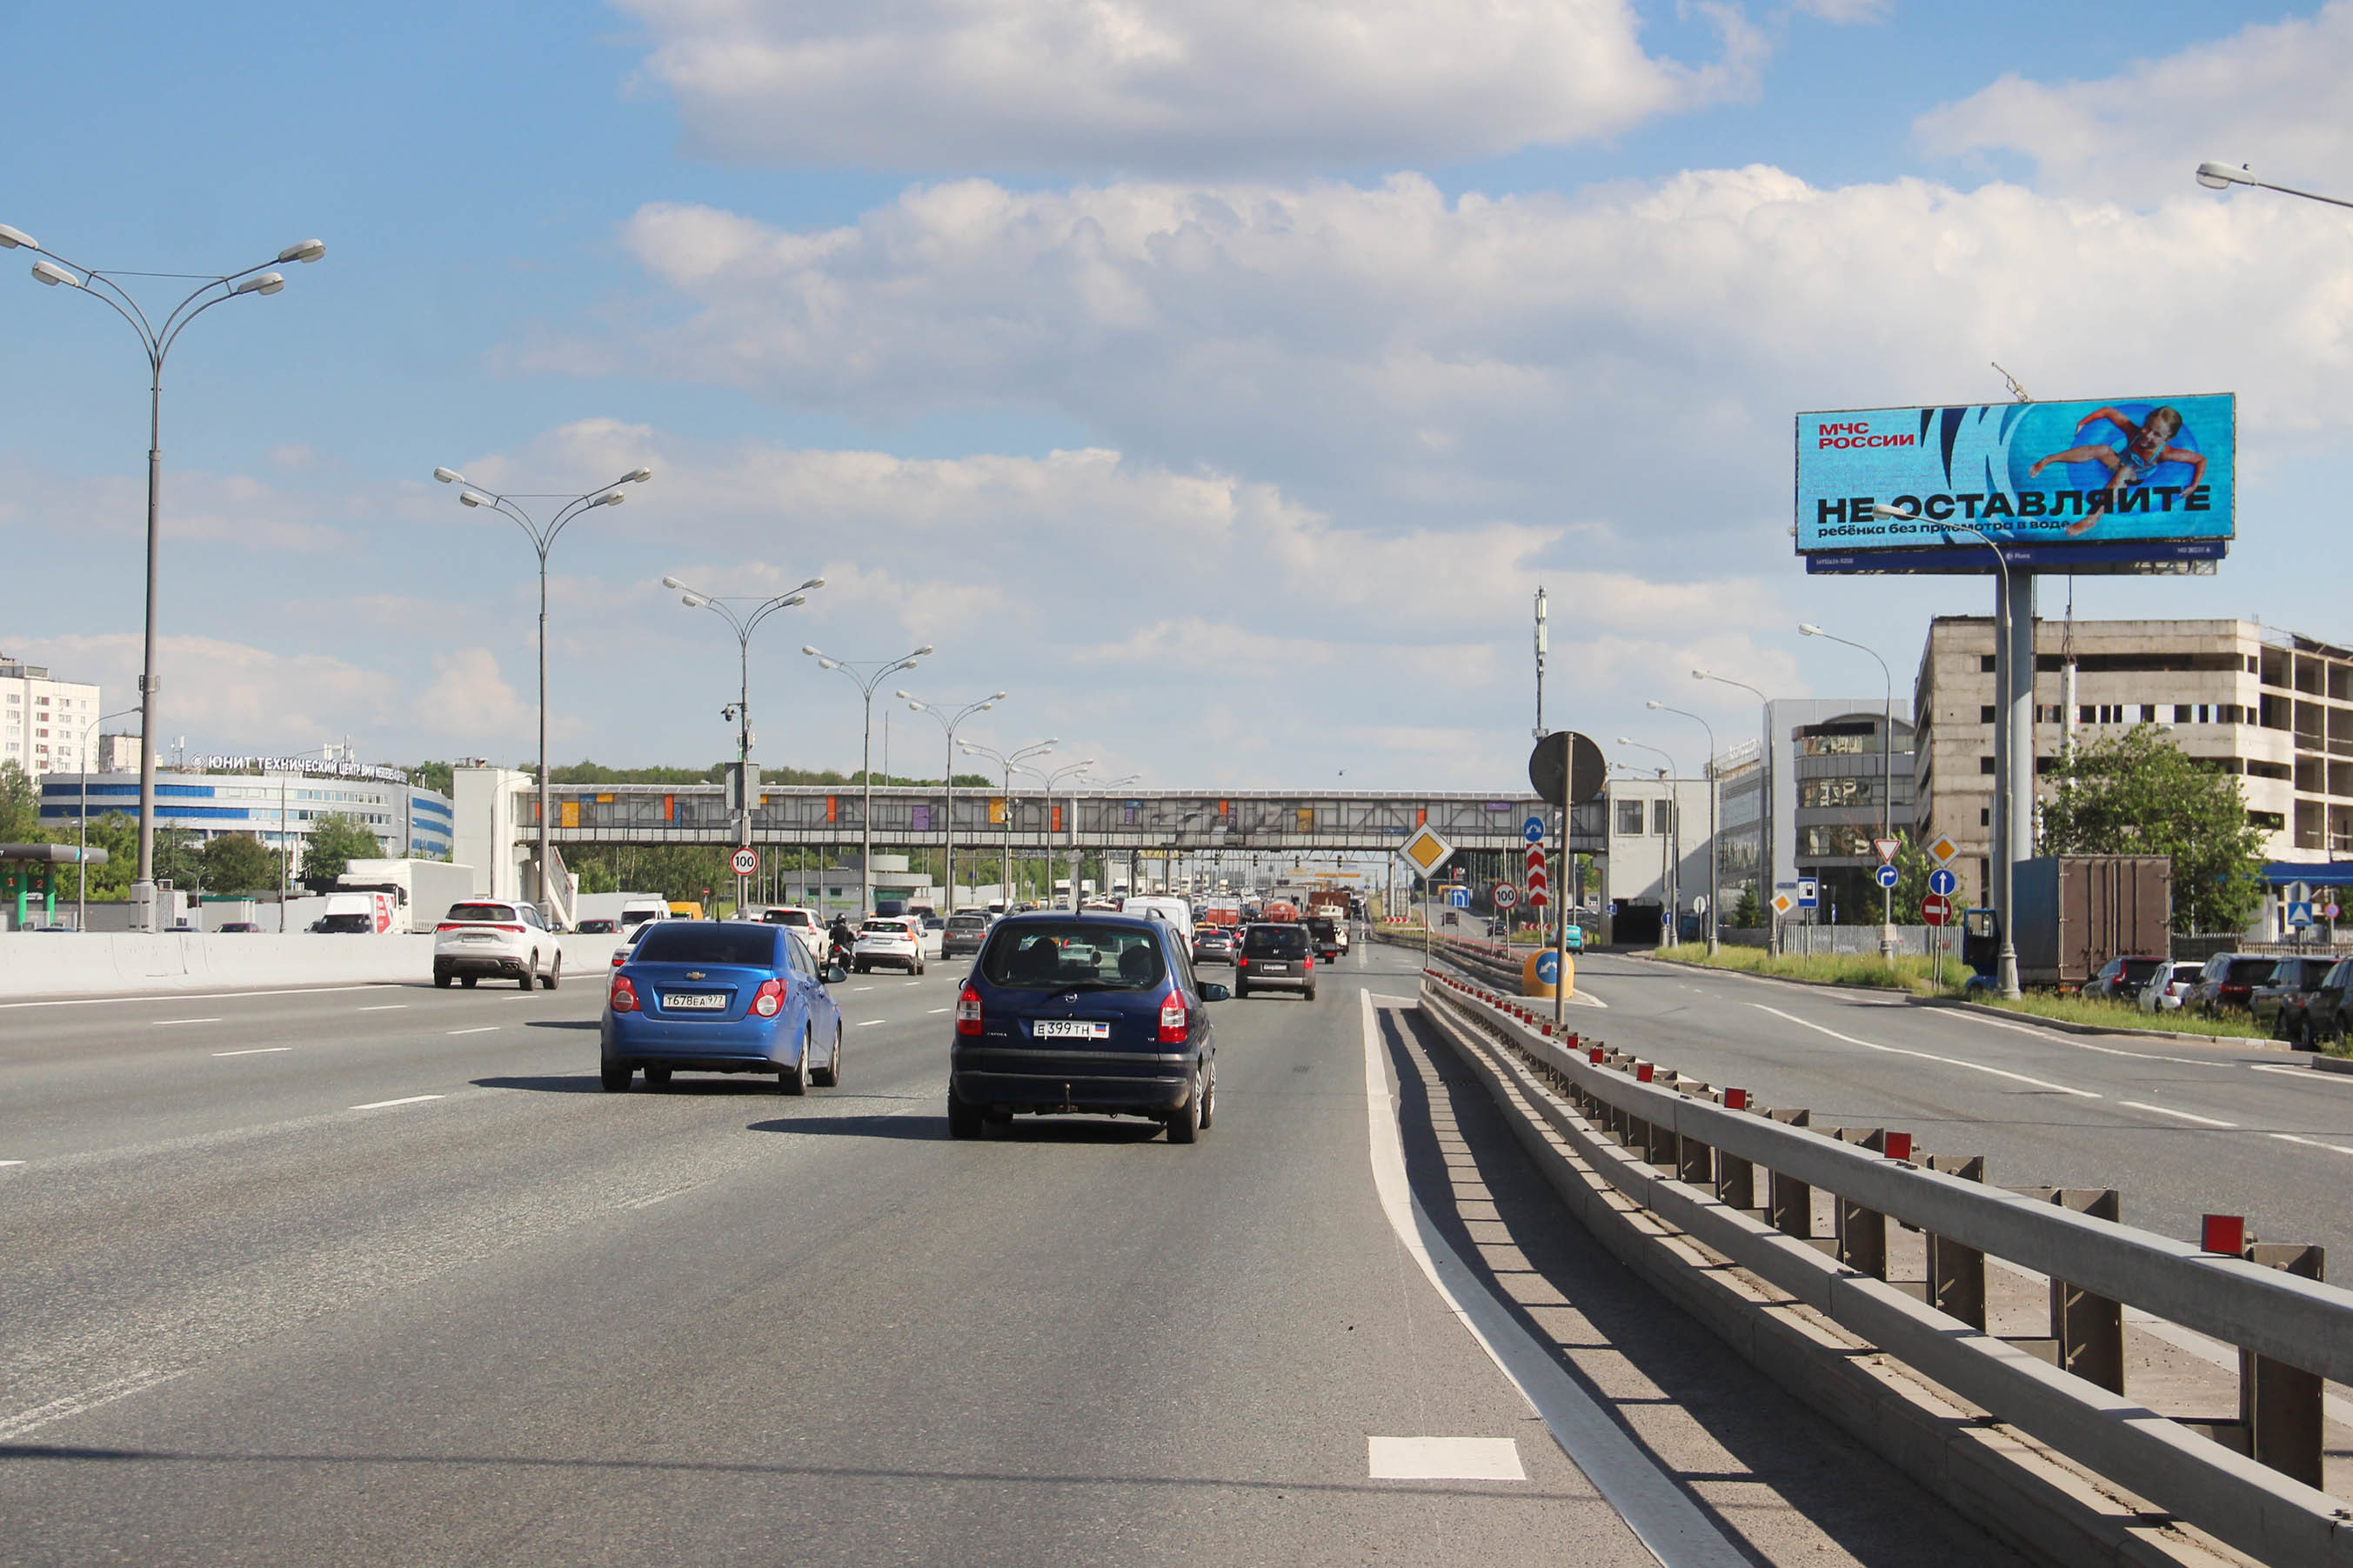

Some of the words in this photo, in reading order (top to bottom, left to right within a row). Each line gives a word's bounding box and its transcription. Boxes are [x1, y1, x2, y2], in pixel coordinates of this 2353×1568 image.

[1819, 423, 1869, 436] МЧС
[1819, 434, 1915, 450] РОССИИ
[1817, 497, 1875, 524] НЕ
[1891, 479, 2211, 521] ОСТАВЛЯЙТЕ
[1818, 525, 1886, 538] ребёнка
[1888, 524, 1917, 534] без
[208, 755, 251, 769] ЮНИТ
[257, 757, 337, 775] ТЕХНИЧЕСКИЙ
[338, 759, 361, 777] ЦЕНТР
[735, 856, 754, 867] 100
[8, 877, 15, 887] 1
[1496, 890, 1514, 902] 100
[667, 995, 705, 1006] Т678ЕА
[707, 995, 723, 1004] 977
